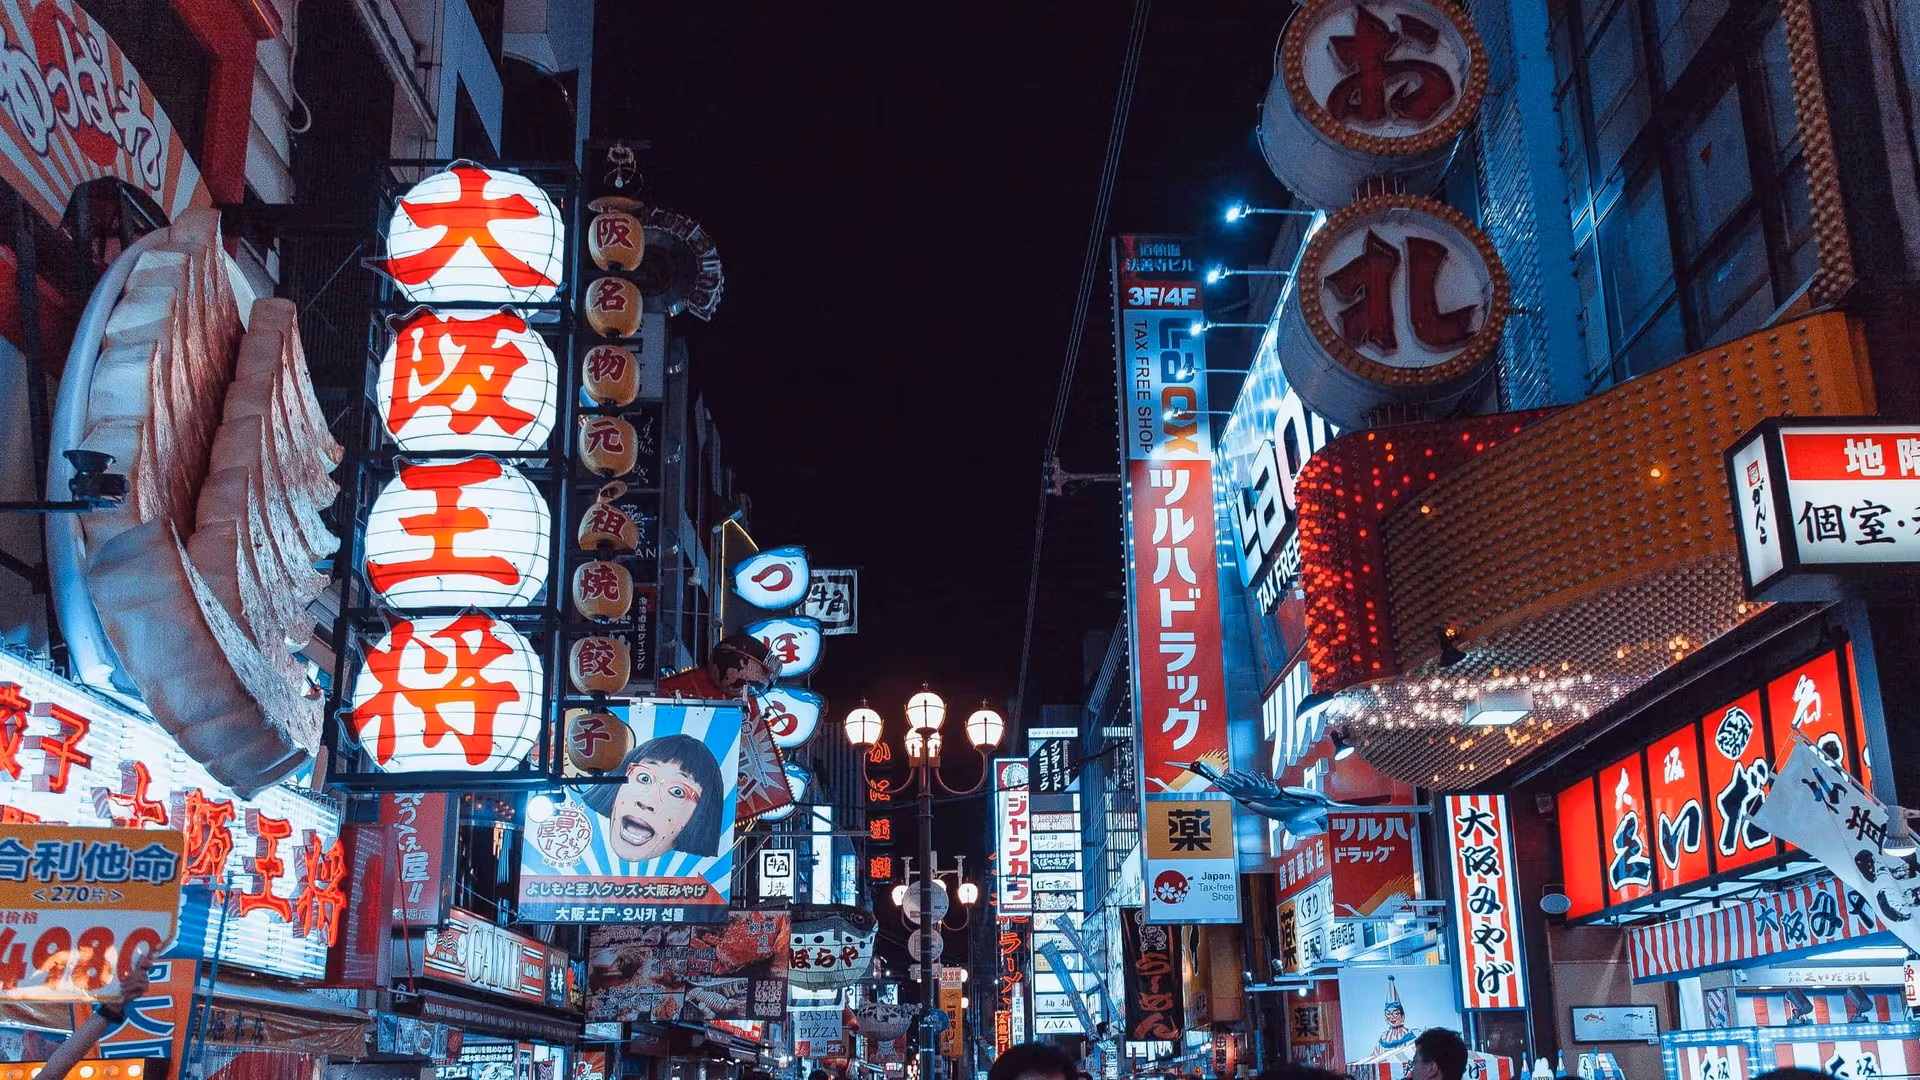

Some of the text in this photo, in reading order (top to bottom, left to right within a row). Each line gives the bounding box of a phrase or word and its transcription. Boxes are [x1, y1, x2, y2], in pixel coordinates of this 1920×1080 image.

[1128, 287, 1196, 306] 3F/4F
[1134, 320, 1154, 455] TAX FREE SHOP
[345, 163, 560, 766] 大阪王将
[1236, 386, 1340, 588] LaO
[1149, 469, 1207, 750] ツルハドラッグ
[1256, 574, 1277, 616] TAX
[1008, 795, 1030, 902] ジャンカラ
[1168, 808, 1212, 851] 薬
[1332, 817, 1409, 841] ツルハ
[105, 761, 347, 949] 大阪王将
[1334, 846, 1395, 864] ドラッグ
[525, 882, 708, 898] よしもと芸人グッズ・大阪みやげ
[1197, 882, 1234, 891] Tax-free
[1201, 872, 1233, 882] Japan.
[1211, 892, 1235, 902] Shop
[1457, 807, 1514, 995] 大阪みやげ
[800, 1028, 839, 1038] PIZZA
